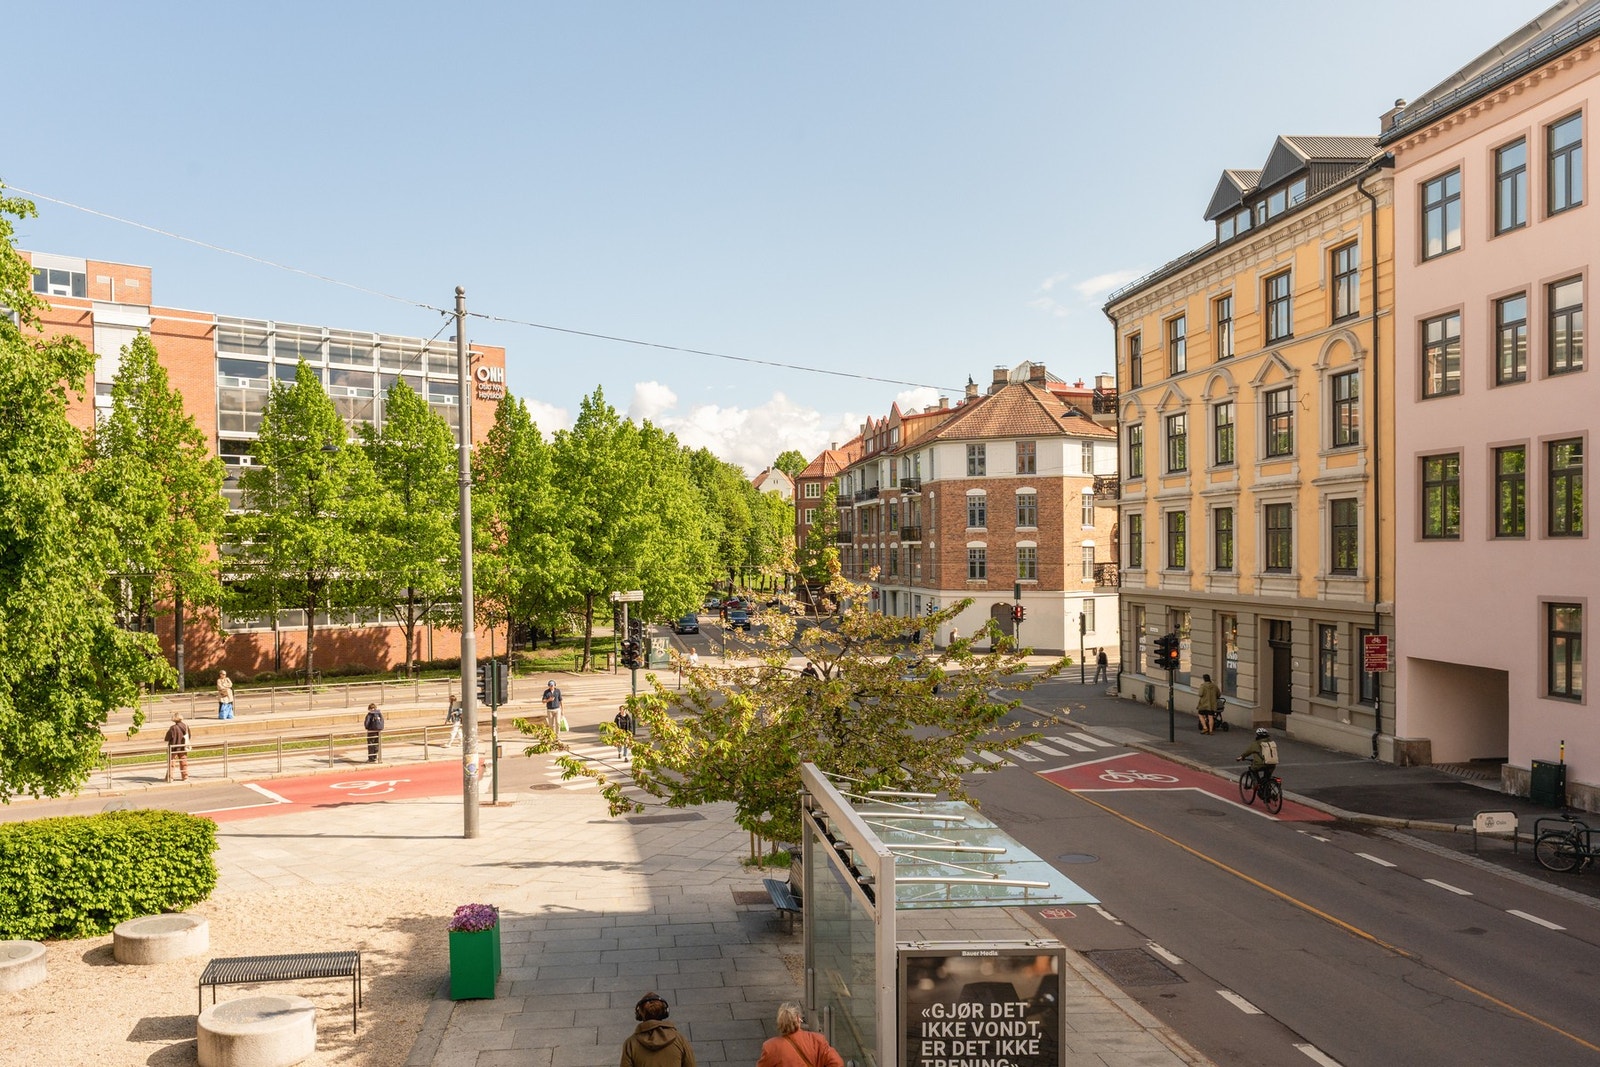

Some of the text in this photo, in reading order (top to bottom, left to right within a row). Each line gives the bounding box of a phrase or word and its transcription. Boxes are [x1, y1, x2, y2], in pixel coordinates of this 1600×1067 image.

[477, 366, 504, 382] ONH
[921, 1002, 1028, 1019] «GJØR DET
[922, 1020, 1042, 1039] IKKE VONDT,
[921, 1039, 1040, 1056] ER DET IKKE
